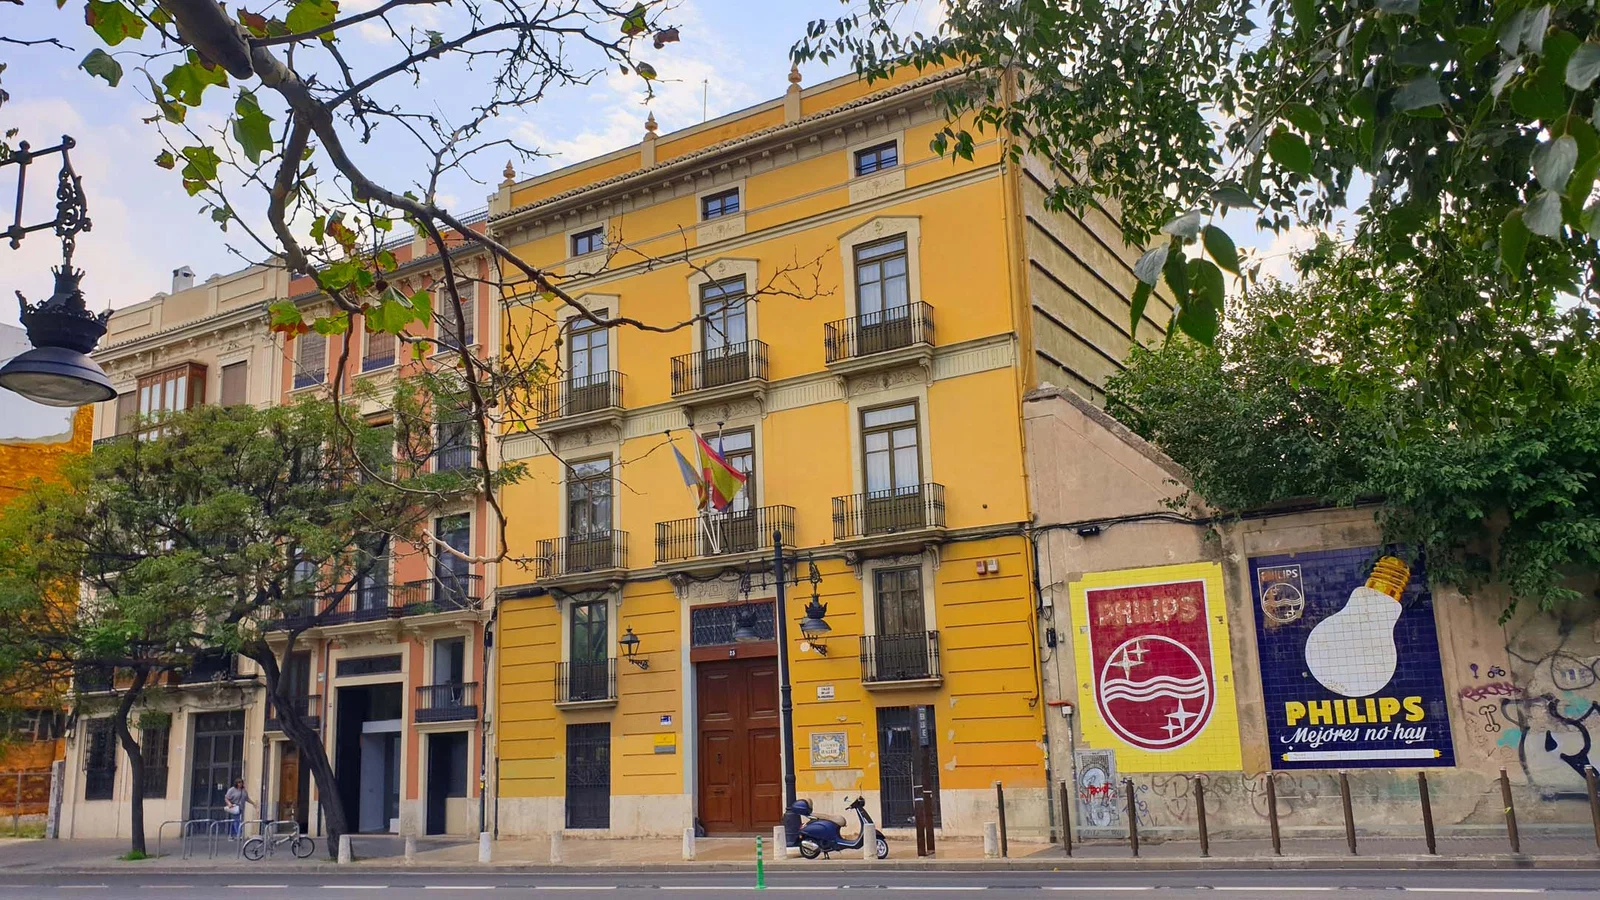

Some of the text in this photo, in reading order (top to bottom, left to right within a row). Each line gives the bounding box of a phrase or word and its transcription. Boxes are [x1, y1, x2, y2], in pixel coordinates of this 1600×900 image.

[1285, 696, 1425, 726] PHILIPS
[1280, 722, 1428, 749] Mejores no hay
